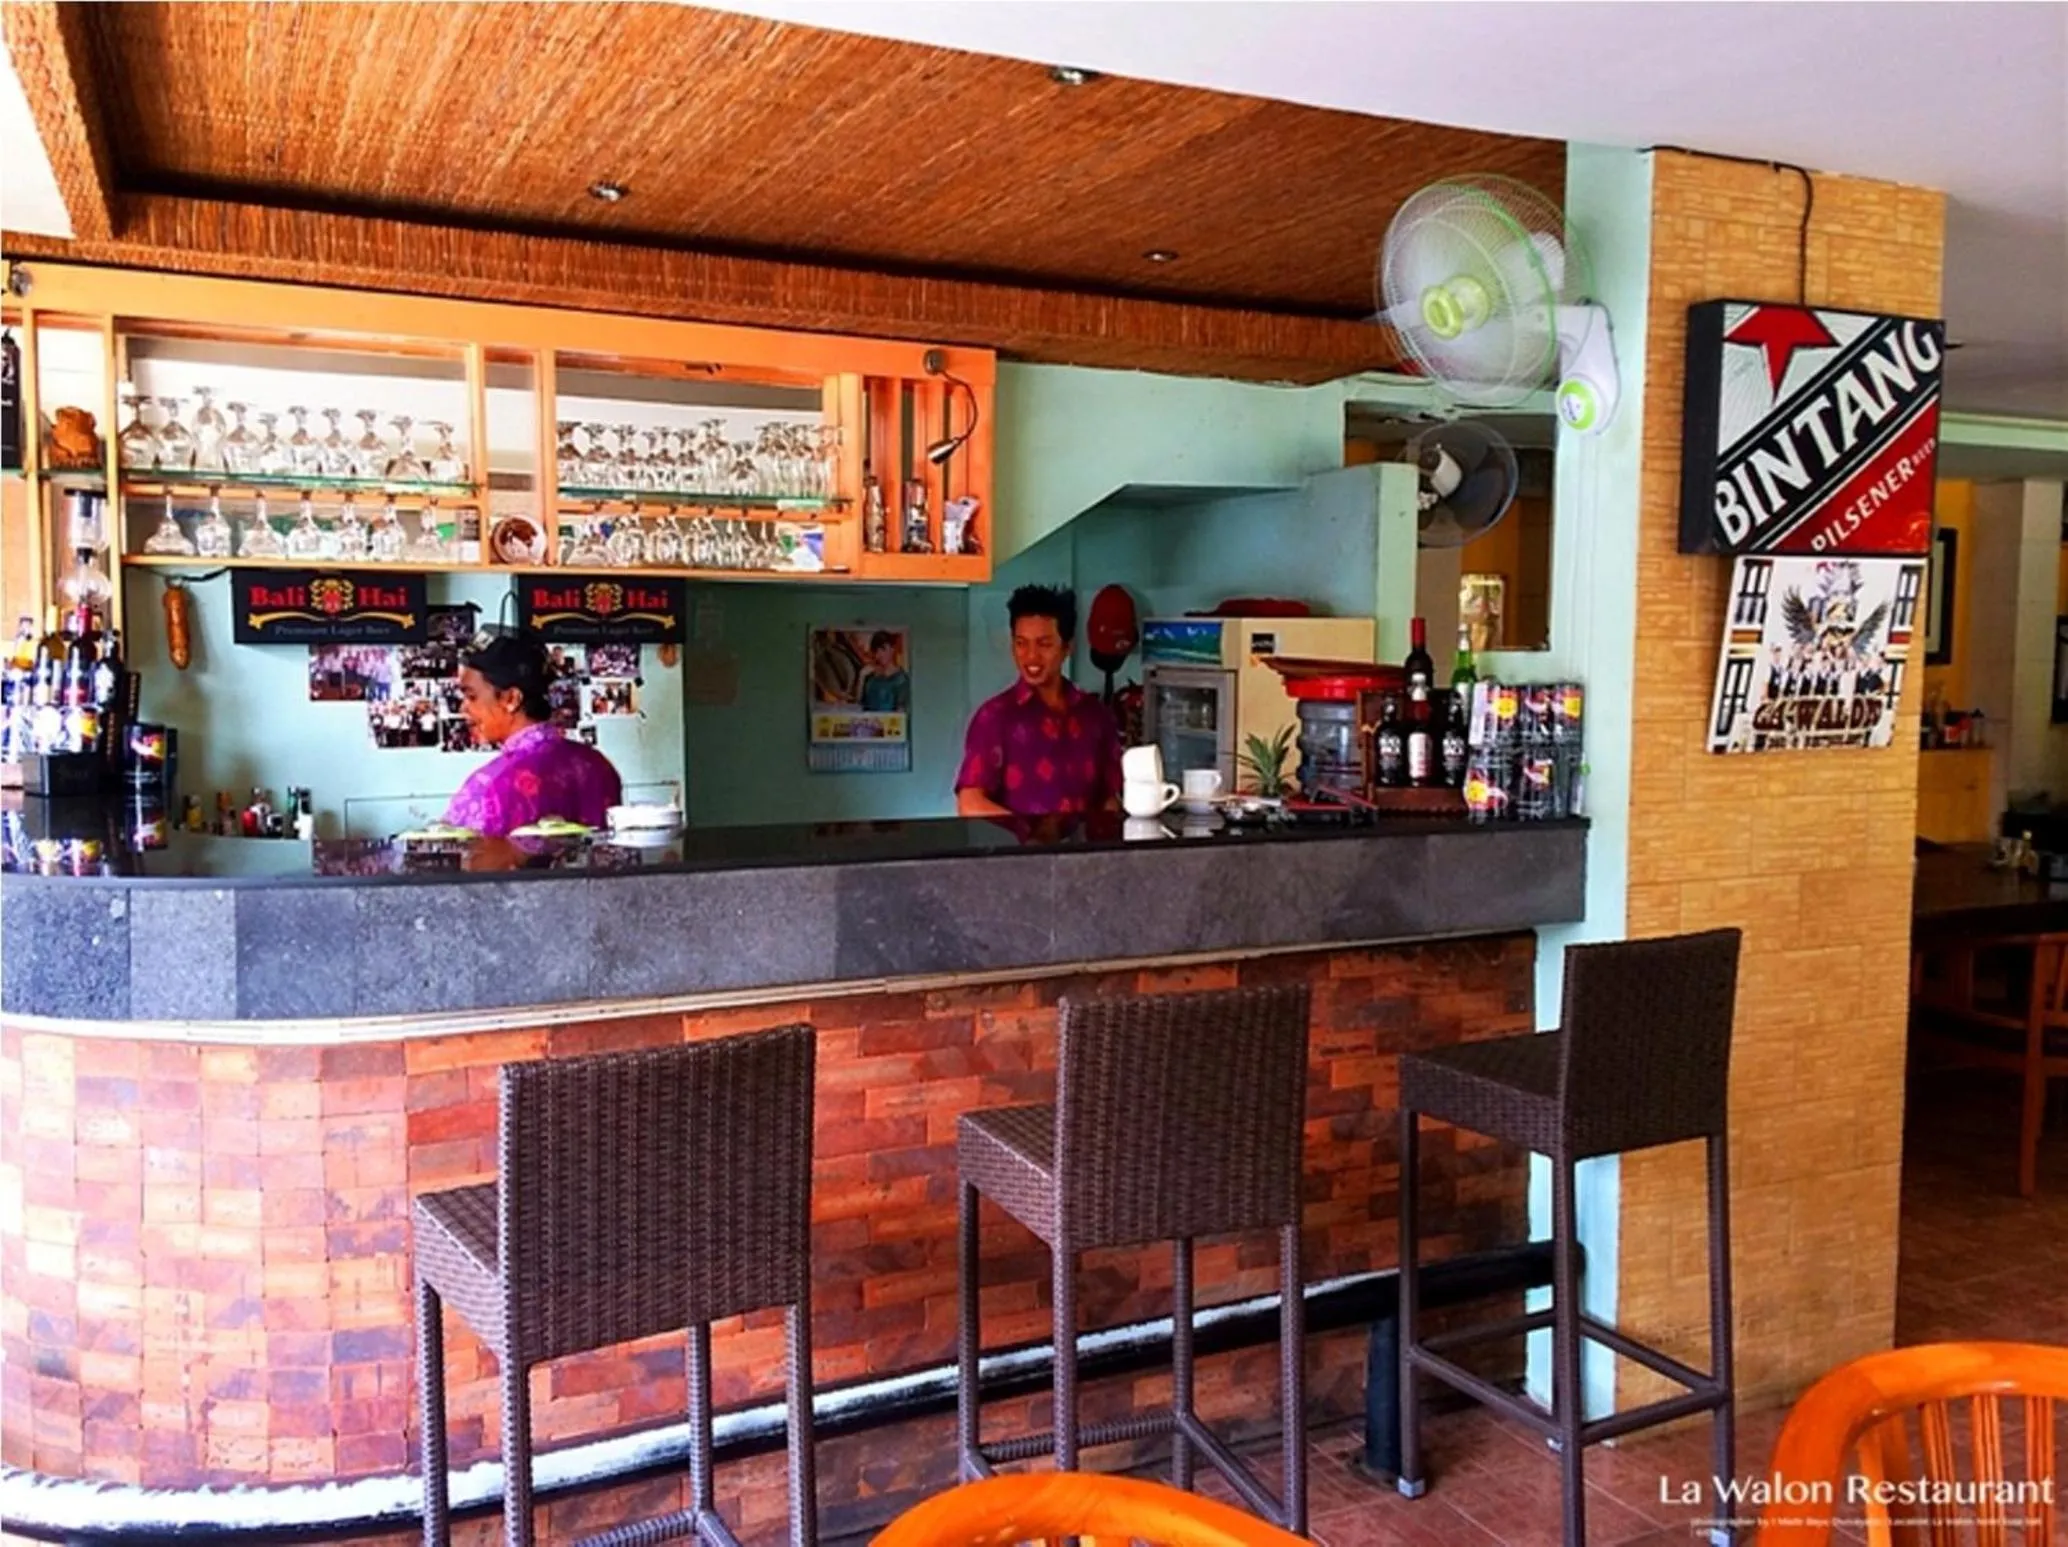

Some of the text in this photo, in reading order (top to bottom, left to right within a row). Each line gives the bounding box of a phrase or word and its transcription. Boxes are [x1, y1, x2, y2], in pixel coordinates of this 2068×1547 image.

[1715, 321, 1940, 546] BINTANG
[1811, 456, 1915, 552] PILSENER
[250, 586, 407, 606] Bali Hai
[533, 589, 669, 608] Bali Hai
